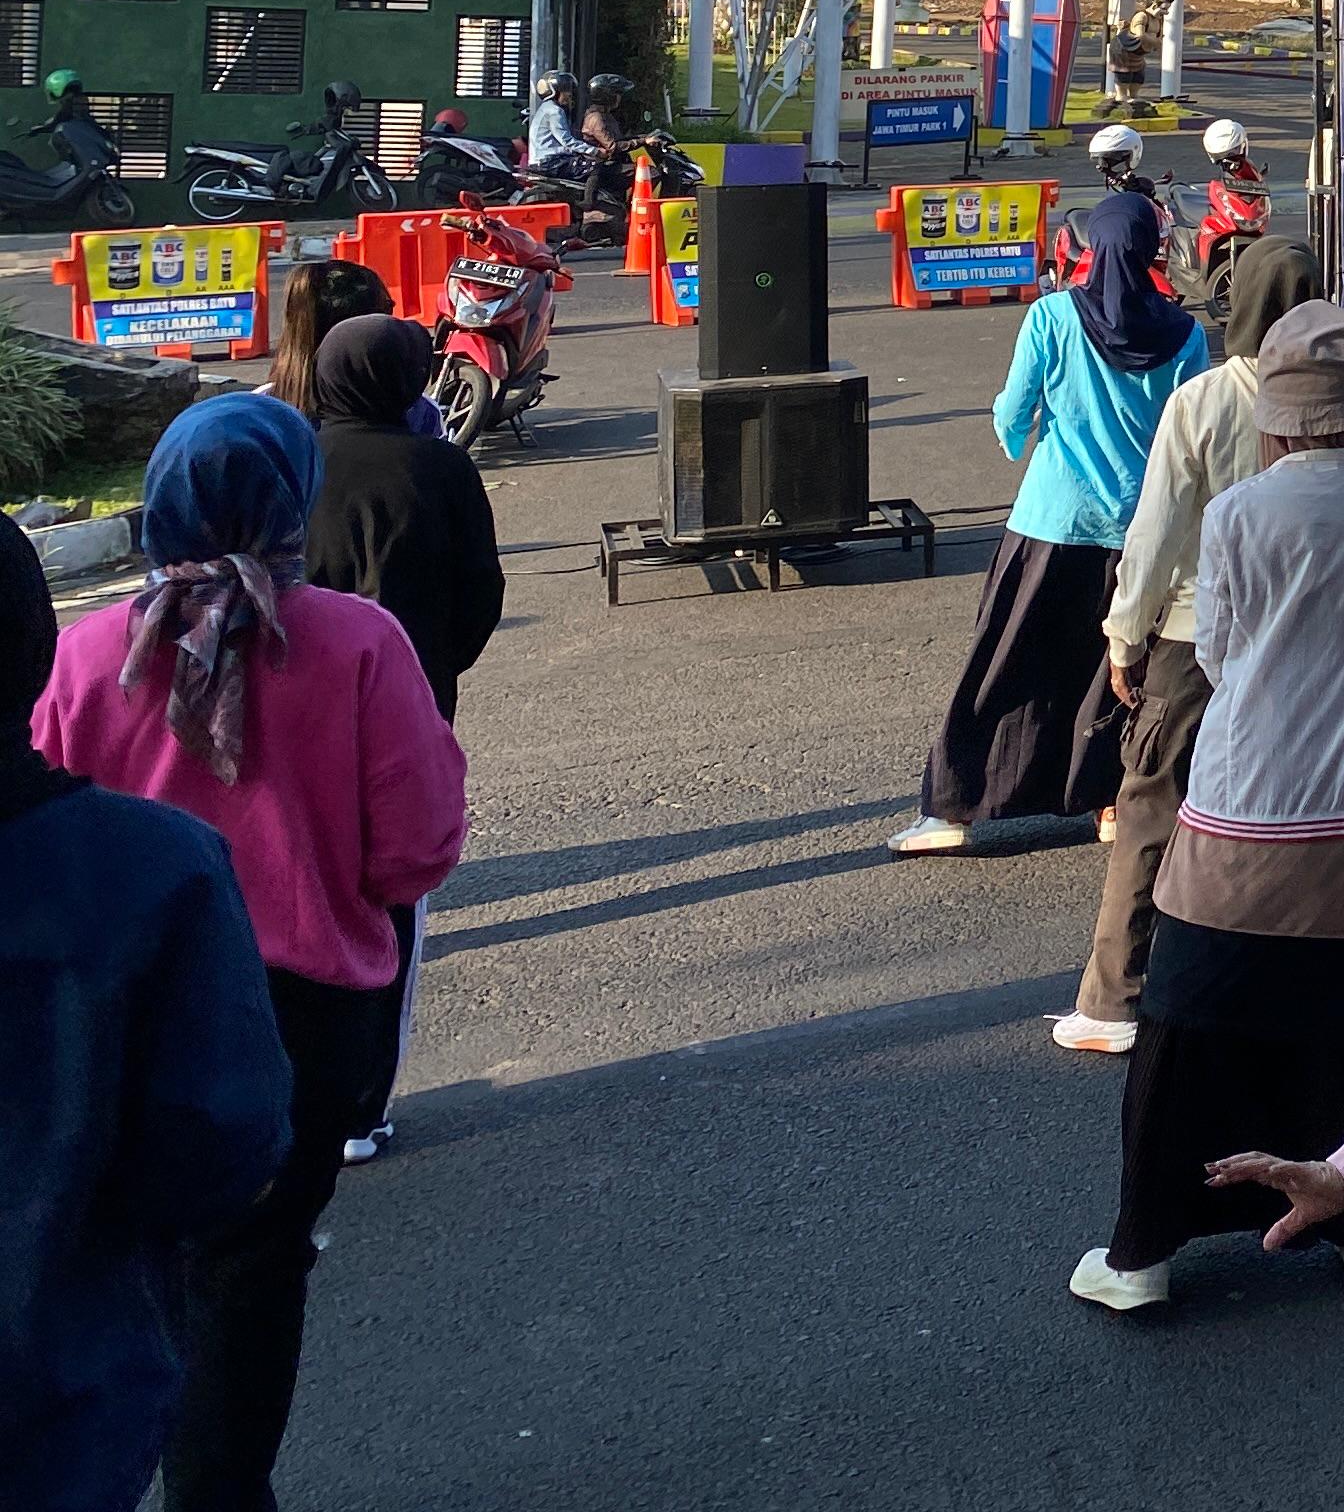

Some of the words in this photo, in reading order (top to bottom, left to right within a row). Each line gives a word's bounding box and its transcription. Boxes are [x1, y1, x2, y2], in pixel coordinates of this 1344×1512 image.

[854, 76, 917, 85] DILARANG
[920, 74, 964, 83] PARKIR
[841, 92, 854, 100] DI
[857, 90, 890, 100] AREA
[894, 89, 931, 99] PINTU
[935, 88, 979, 97] MASUK
[886, 107, 909, 118] PINTU
[911, 105, 939, 116] MASUK
[872, 124, 894, 135] JAWA
[896, 123, 919, 133] TIMUR
[921, 122, 941, 132] PARK
[957, 197, 980, 207] ABC
[923, 205, 945, 213] ABC
[155, 243, 183, 252] ABC
[111, 251, 138, 260] ABC
[935, 268, 968, 281] TERTIB
[970, 267, 986, 279] ITU
[988, 265, 1017, 277] KEREN
[129, 315, 218, 333] KECELAKAAN
